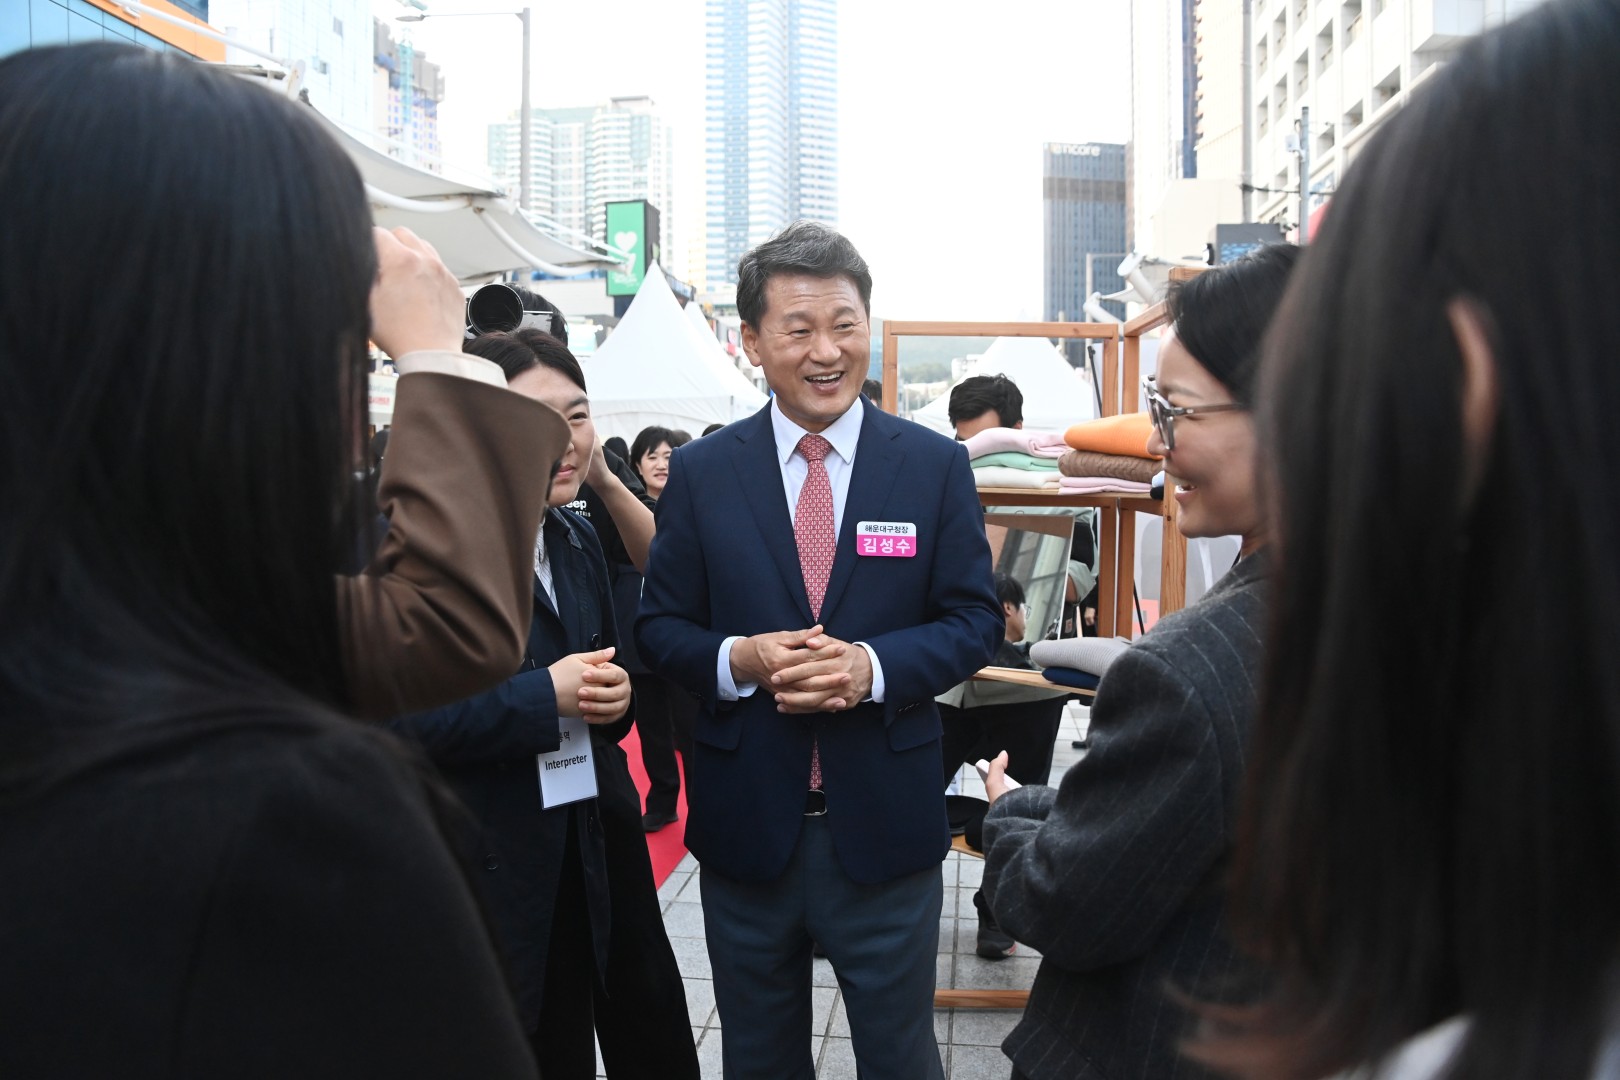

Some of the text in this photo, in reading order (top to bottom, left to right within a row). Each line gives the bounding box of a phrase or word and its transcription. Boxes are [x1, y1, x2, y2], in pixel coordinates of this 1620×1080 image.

[561, 500, 587, 510] eep
[865, 524, 908, 534] 해운대구청장
[863, 537, 910, 554] 김성수
[545, 755, 587, 770] Interpreter
